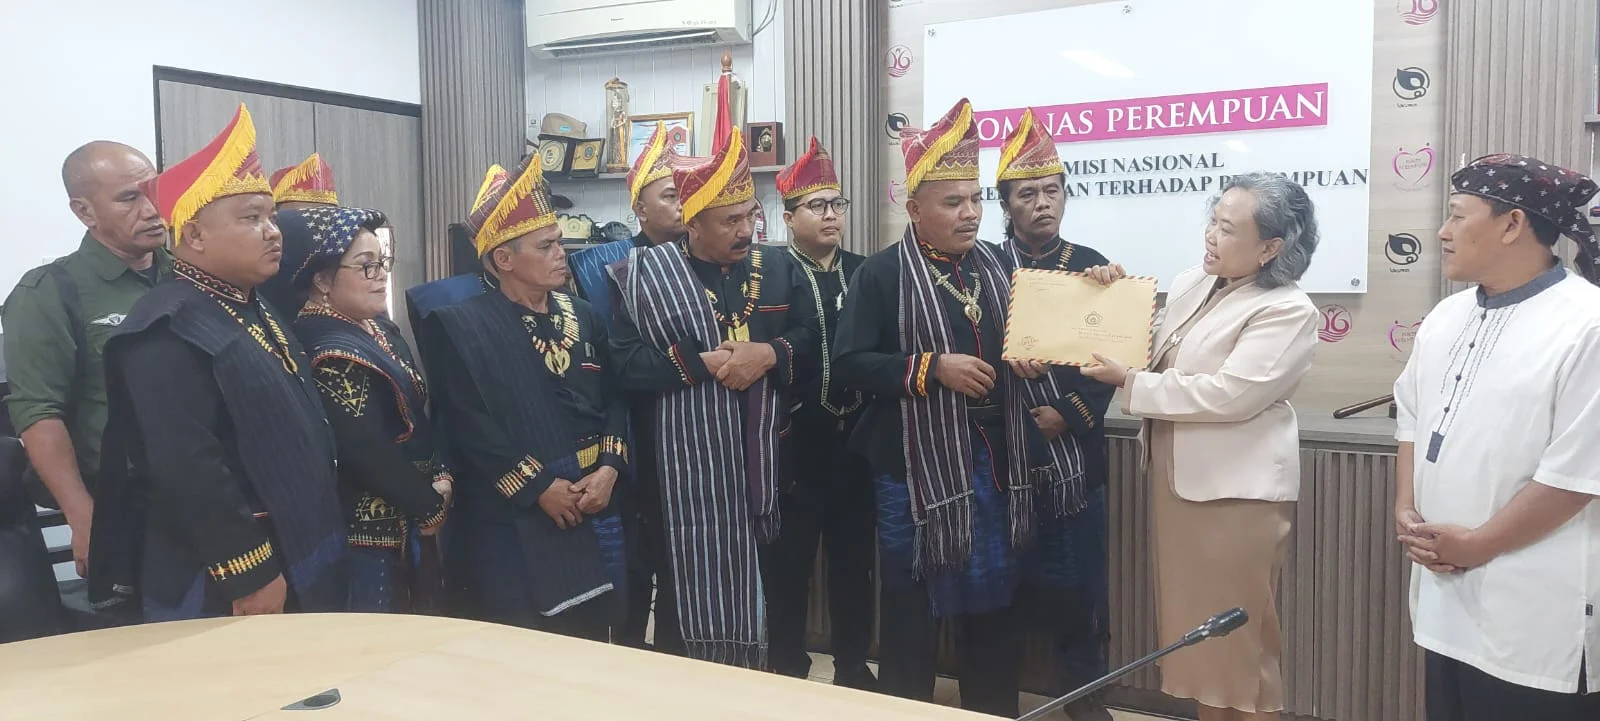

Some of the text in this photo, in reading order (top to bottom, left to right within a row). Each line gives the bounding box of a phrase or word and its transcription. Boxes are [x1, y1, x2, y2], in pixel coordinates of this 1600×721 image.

[976, 90, 1325, 141] OMNAS PEREMPUAN
[1063, 152, 1224, 175] MISI NASIONAL
[1095, 175, 1213, 196] TERHADAP
